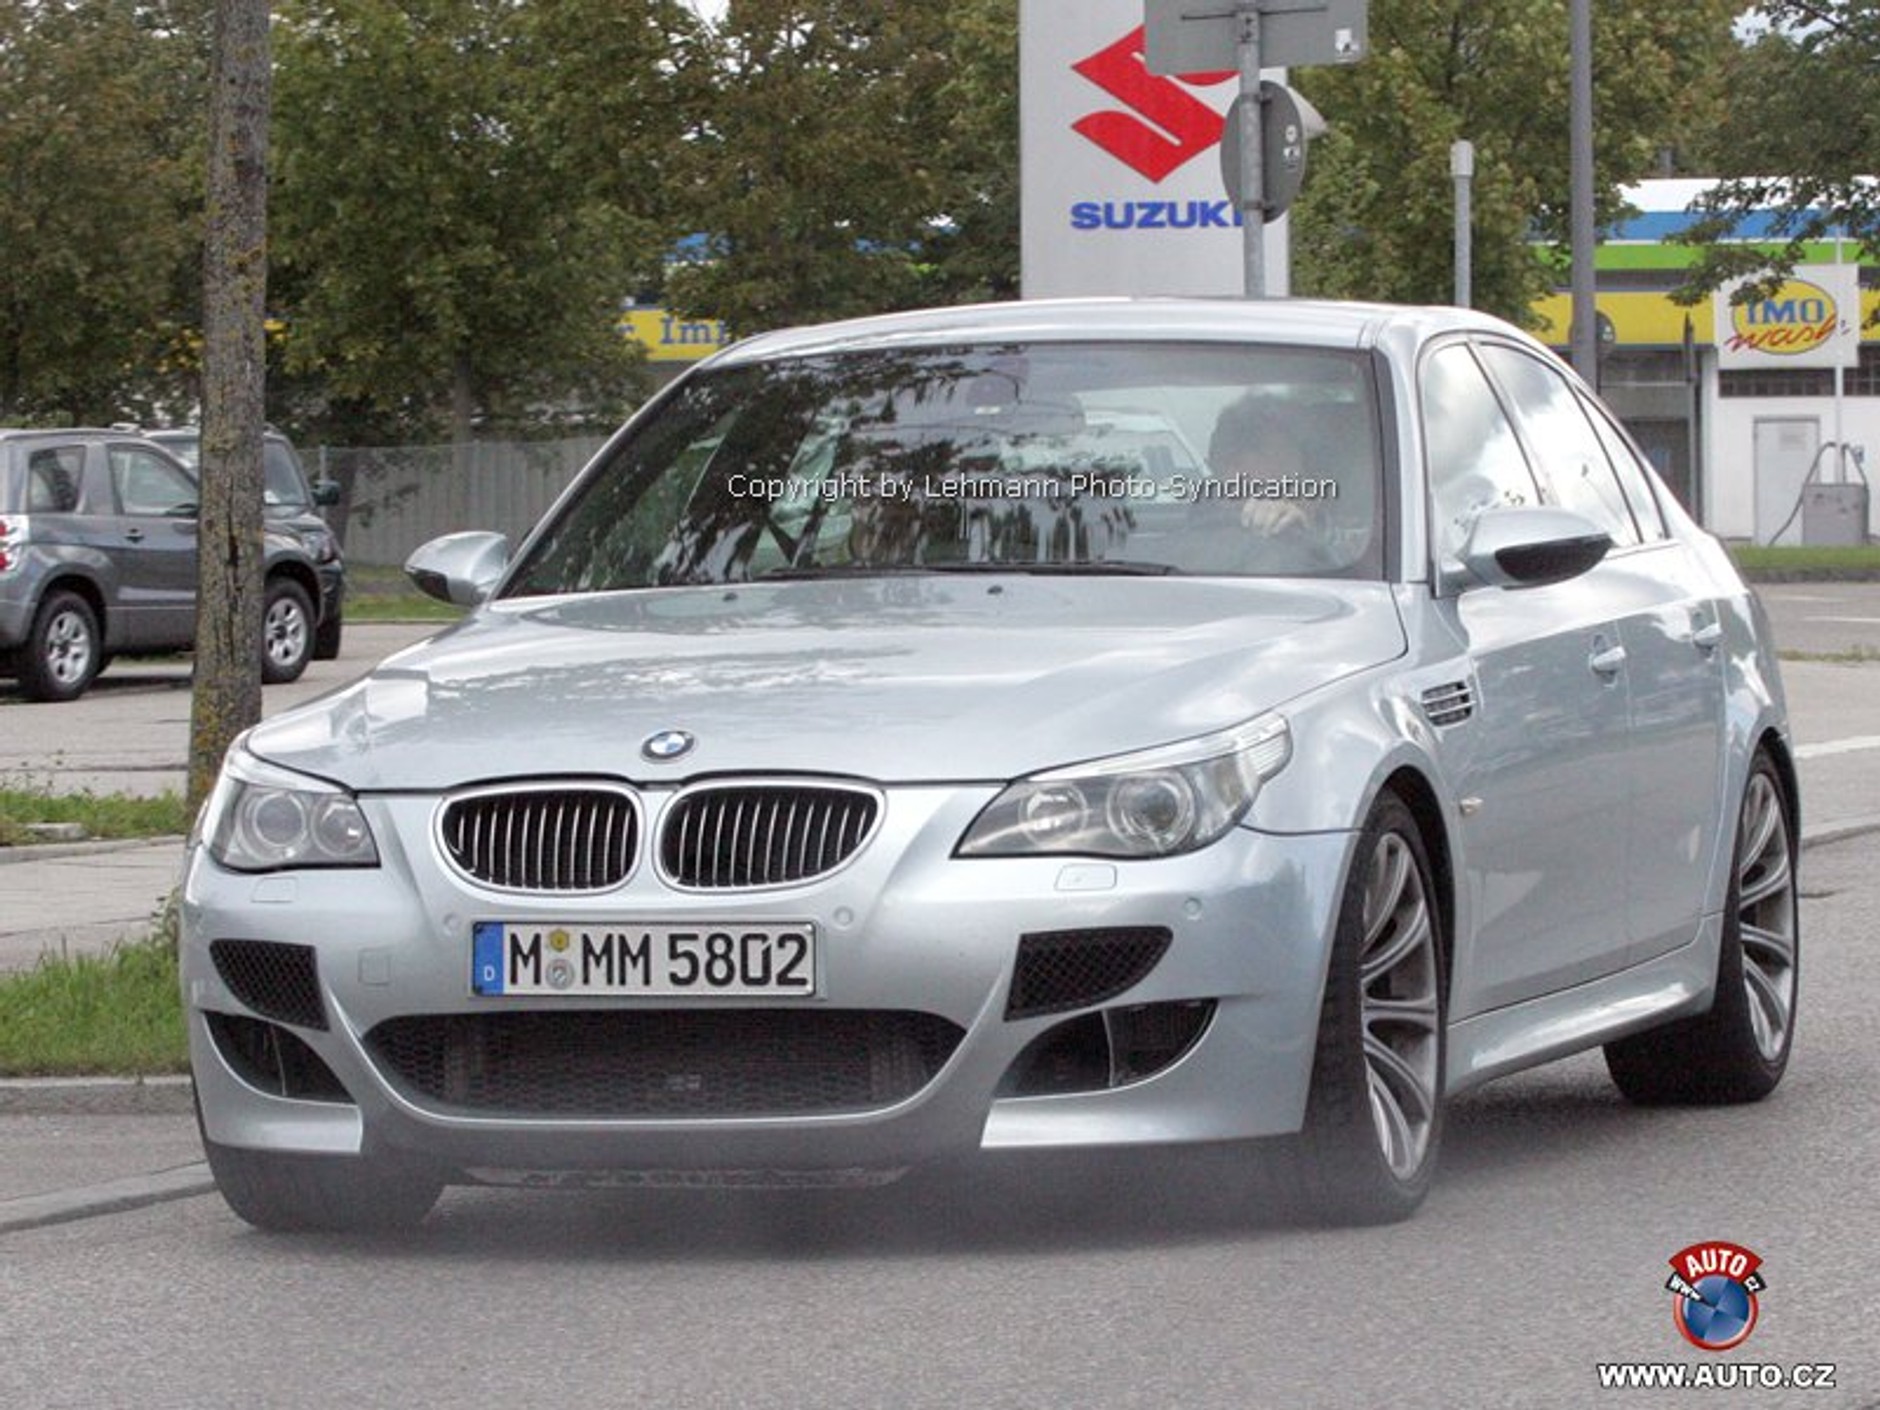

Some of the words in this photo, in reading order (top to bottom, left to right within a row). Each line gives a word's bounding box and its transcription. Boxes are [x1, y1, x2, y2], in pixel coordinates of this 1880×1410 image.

[1746, 297, 1825, 324] IMO
[1723, 311, 1837, 352] wash
[509, 932, 541, 986] M
[582, 932, 651, 986] MM
[668, 932, 809, 987] 5802
